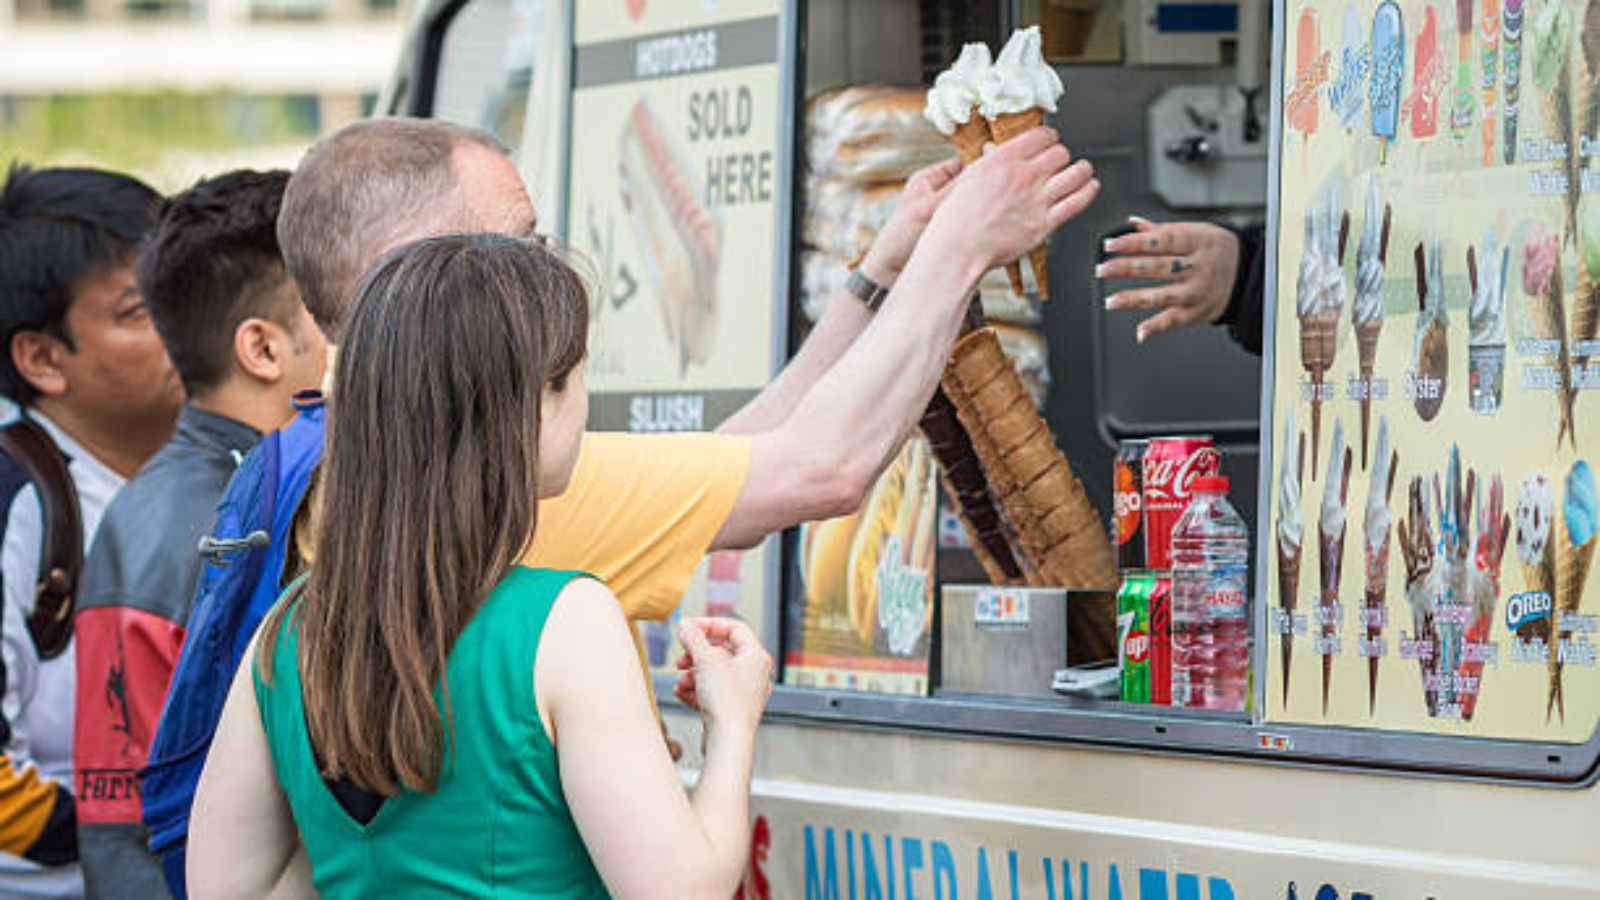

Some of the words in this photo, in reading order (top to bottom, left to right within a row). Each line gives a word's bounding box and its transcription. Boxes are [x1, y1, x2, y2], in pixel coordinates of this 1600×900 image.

[635, 30, 717, 77] HOTDOGS
[688, 86, 752, 141] SOLD
[706, 152, 772, 205] HERE
[629, 396, 704, 432] SLUSH
[1508, 593, 1551, 624] OREO
